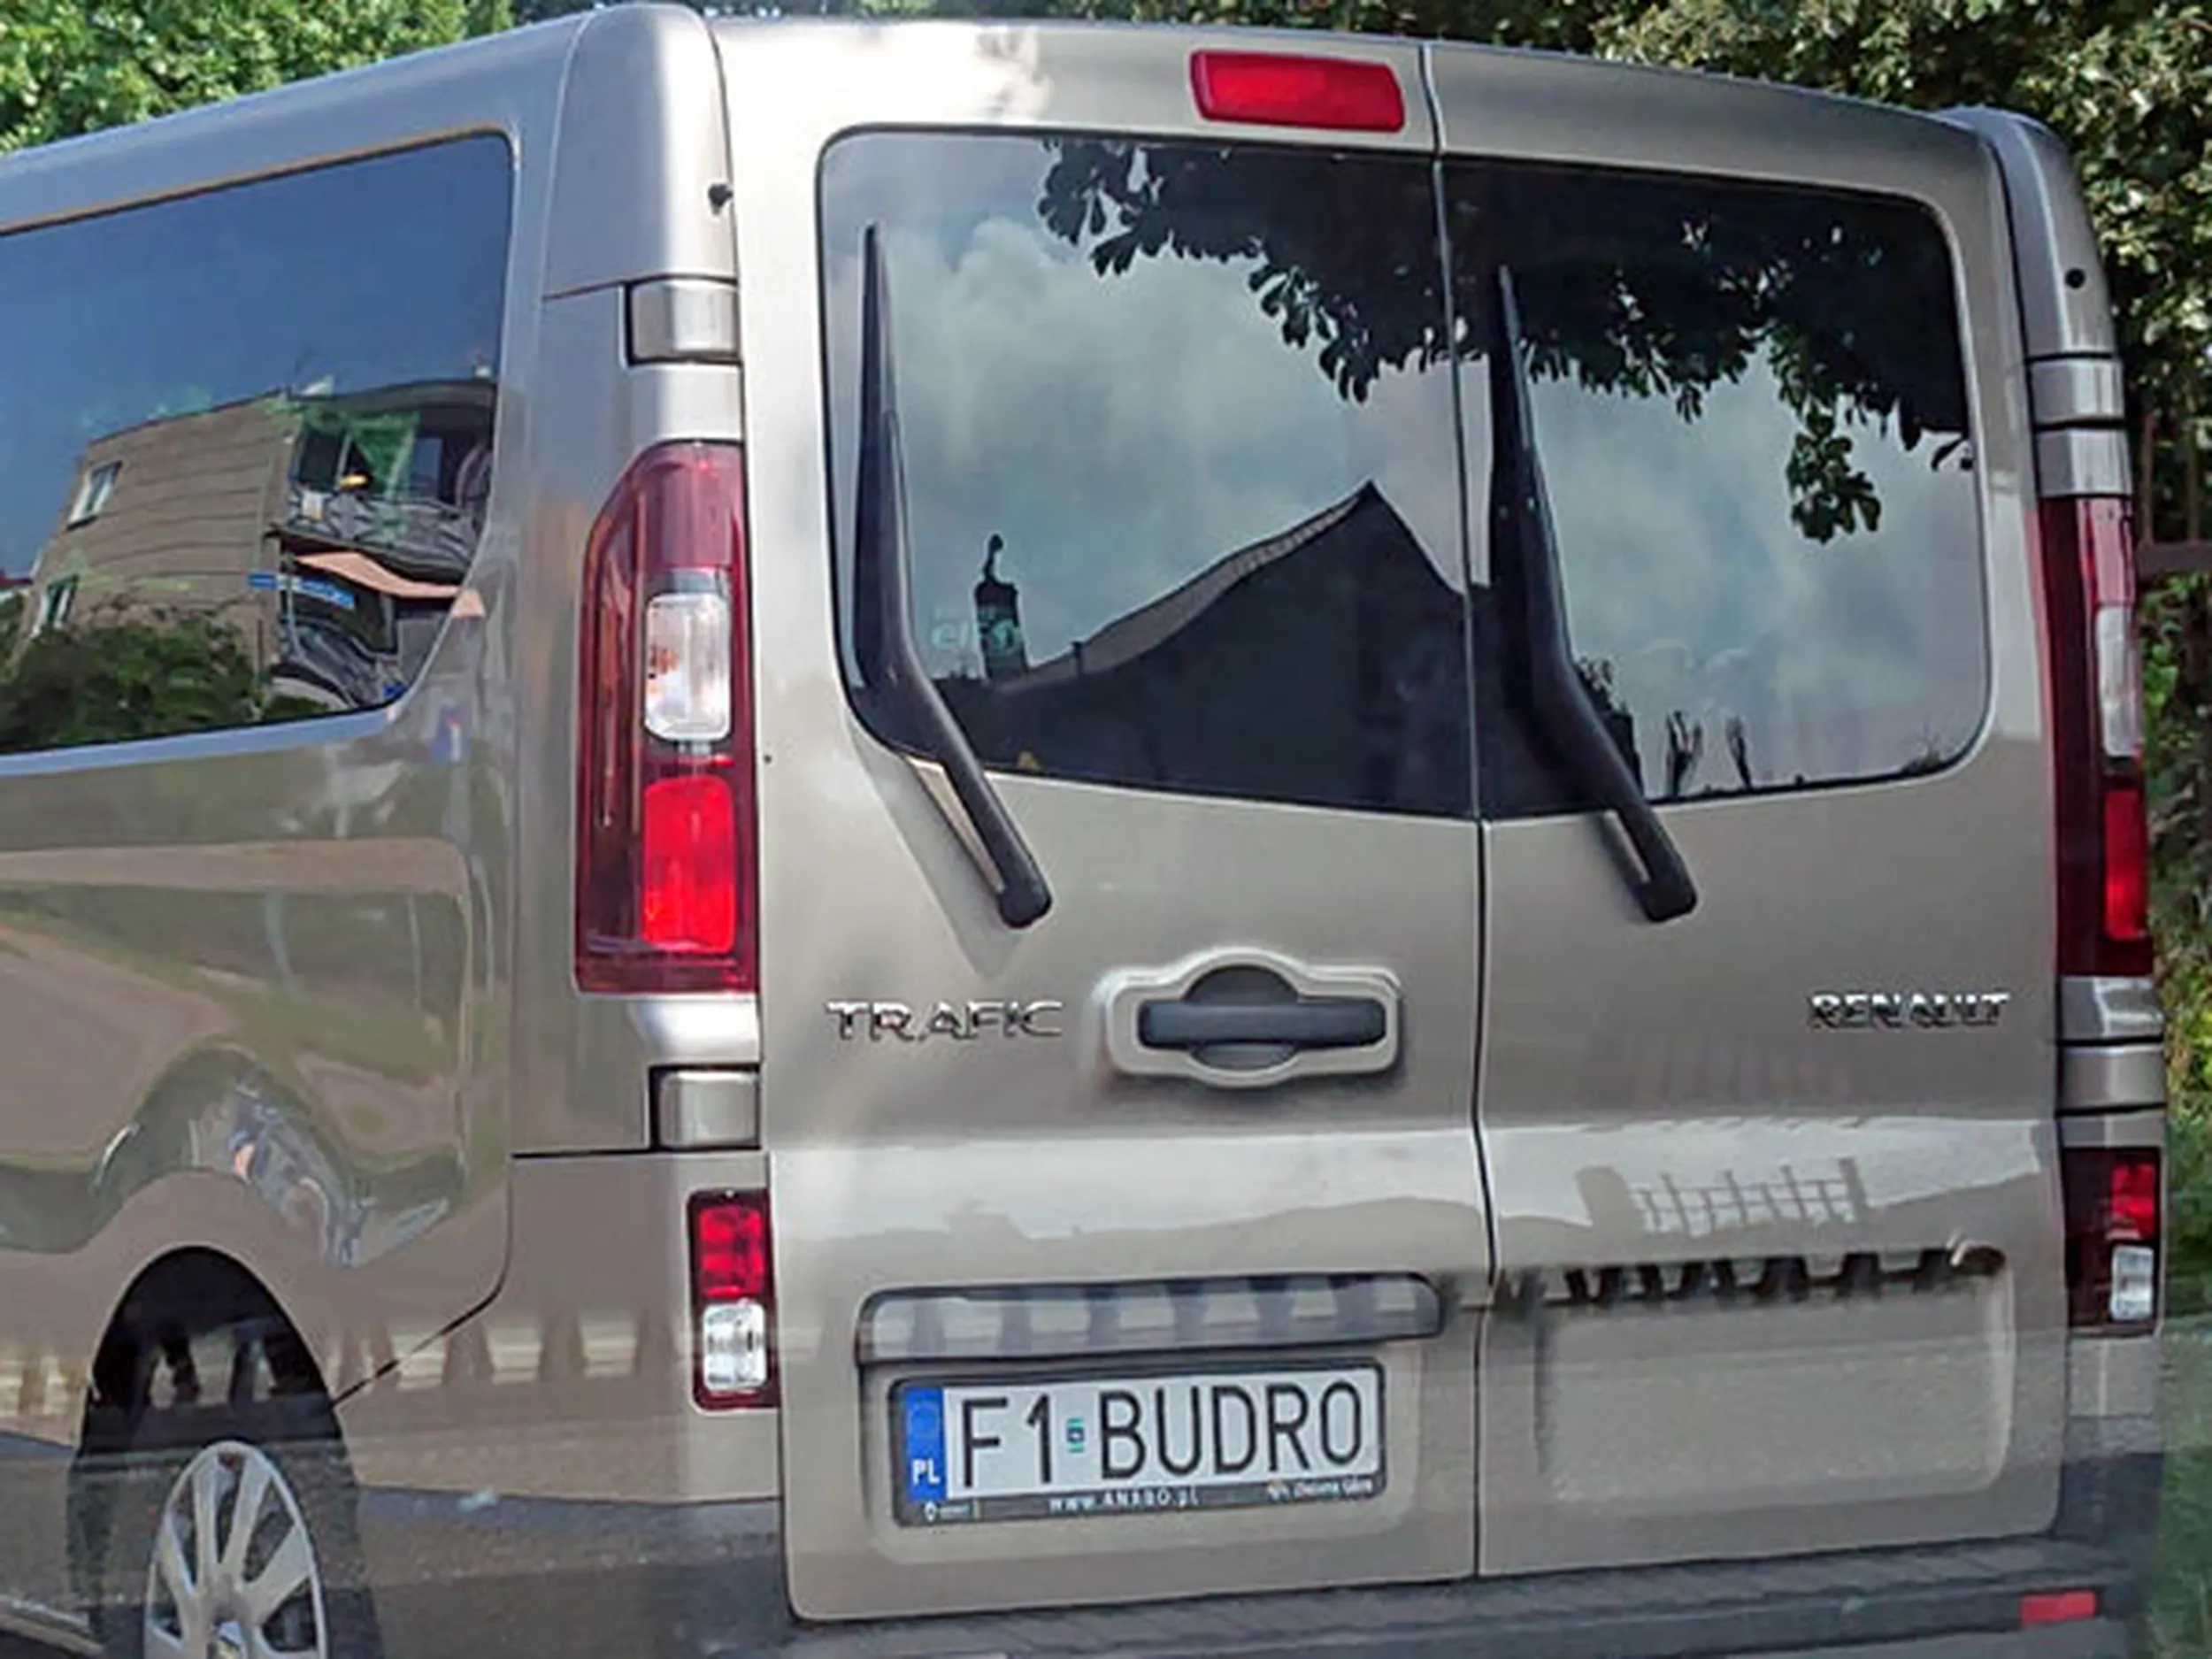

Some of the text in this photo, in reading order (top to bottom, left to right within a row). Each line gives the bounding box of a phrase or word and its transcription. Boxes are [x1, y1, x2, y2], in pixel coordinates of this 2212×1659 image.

[825, 999, 1064, 1041] TRAFIC
[1809, 992, 2013, 1029] RENAULT
[962, 1379, 1363, 1488] F1 BUDRO
[912, 1459, 941, 1486] PL
